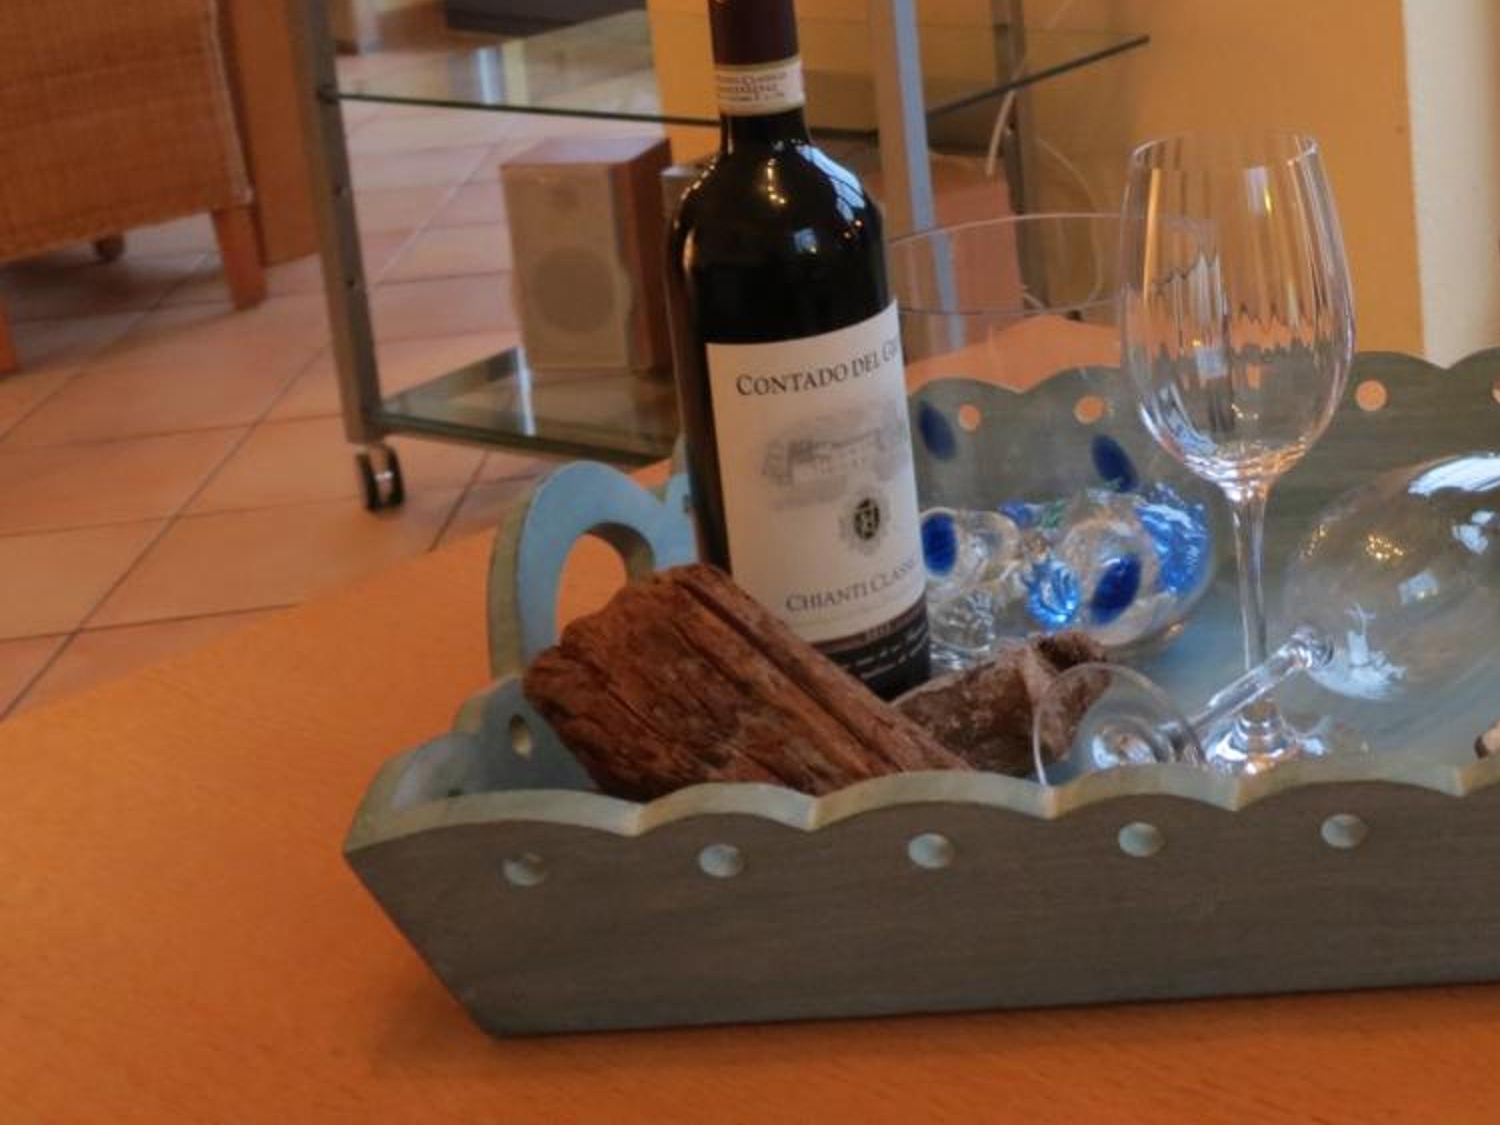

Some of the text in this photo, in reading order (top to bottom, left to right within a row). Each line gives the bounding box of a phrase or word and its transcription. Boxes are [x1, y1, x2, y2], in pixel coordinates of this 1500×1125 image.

[736, 363, 847, 395] CONTADO
[851, 351, 879, 377] DEL
[786, 581, 868, 612] CHIANTI
